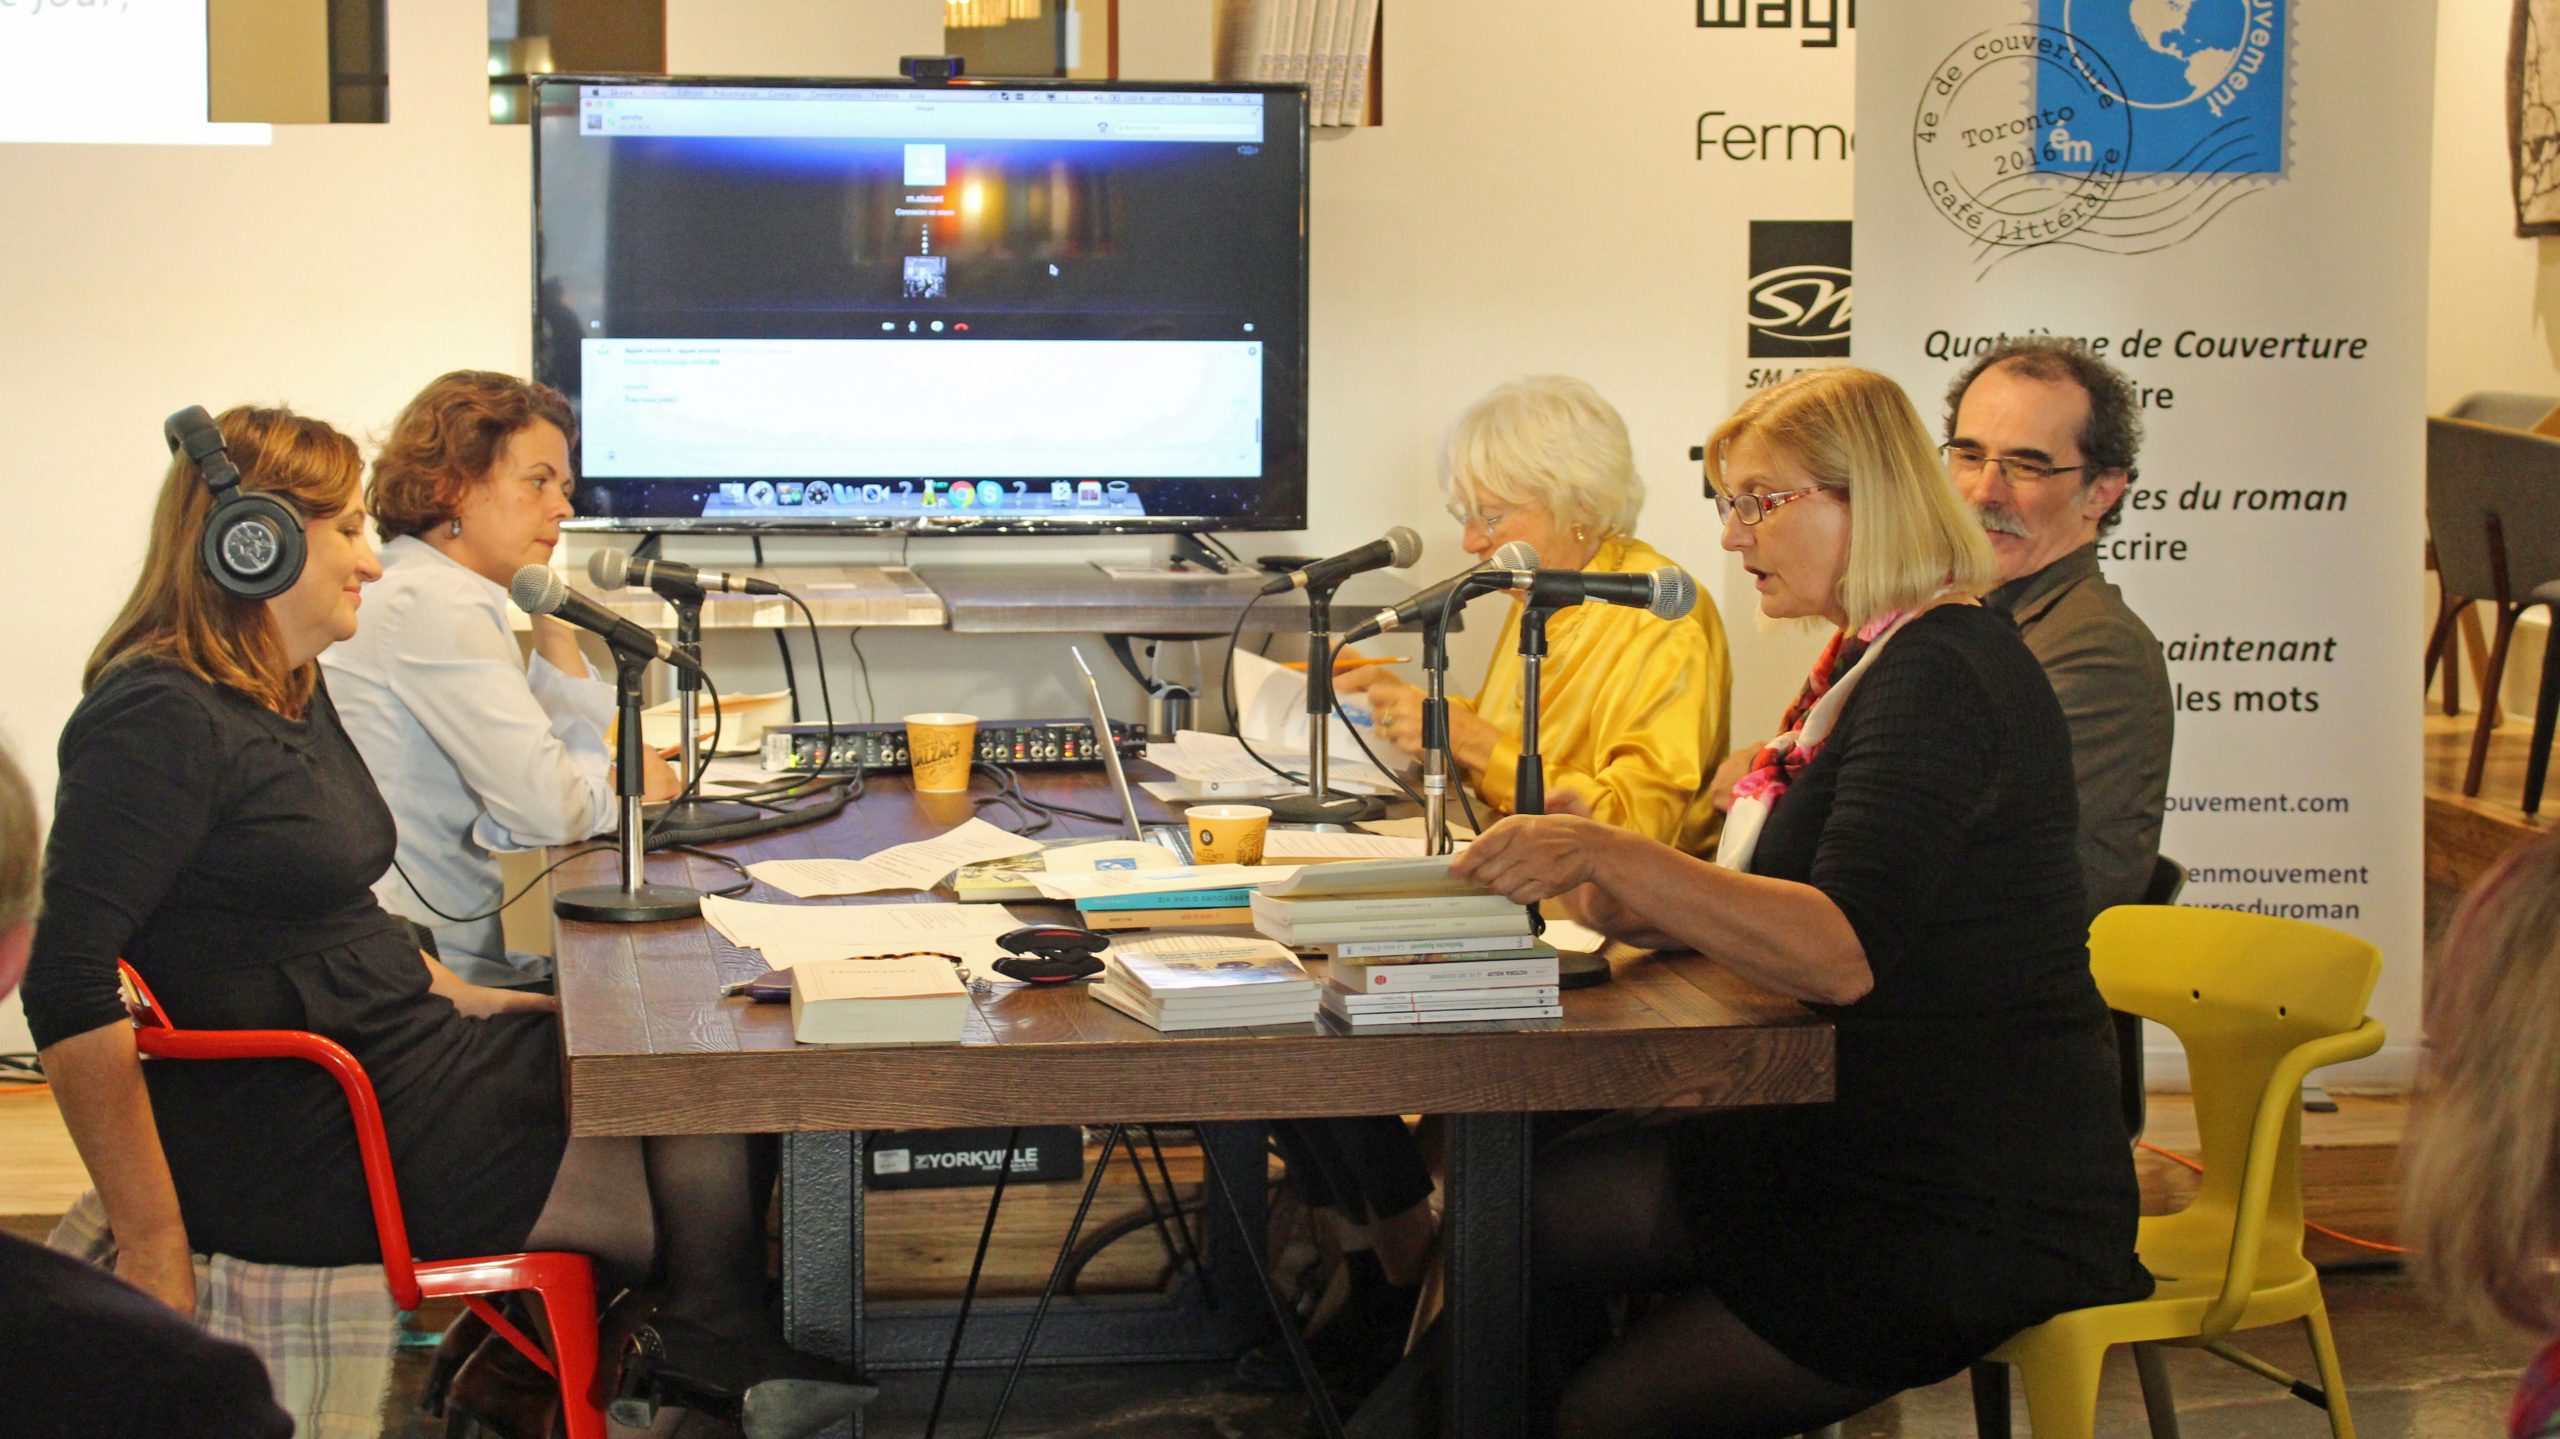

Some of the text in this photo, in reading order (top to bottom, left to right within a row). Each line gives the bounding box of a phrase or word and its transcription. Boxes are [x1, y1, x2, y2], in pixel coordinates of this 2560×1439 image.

[1917, 35, 2114, 143] 4e de couverture
[1696, 111, 1854, 160] Ferm
[1961, 106, 2074, 148] Toronto
[1994, 141, 2057, 175] 2016
[1933, 148, 2120, 240] café littéraire
[2120, 330, 2162, 359] de
[2174, 330, 2368, 359] Couverture
[2126, 481, 2348, 511] es du roman
[2158, 633, 2337, 662] aintenant
[2176, 683, 2319, 712] les mots
[928, 1147, 1038, 1169] YORKVILE
